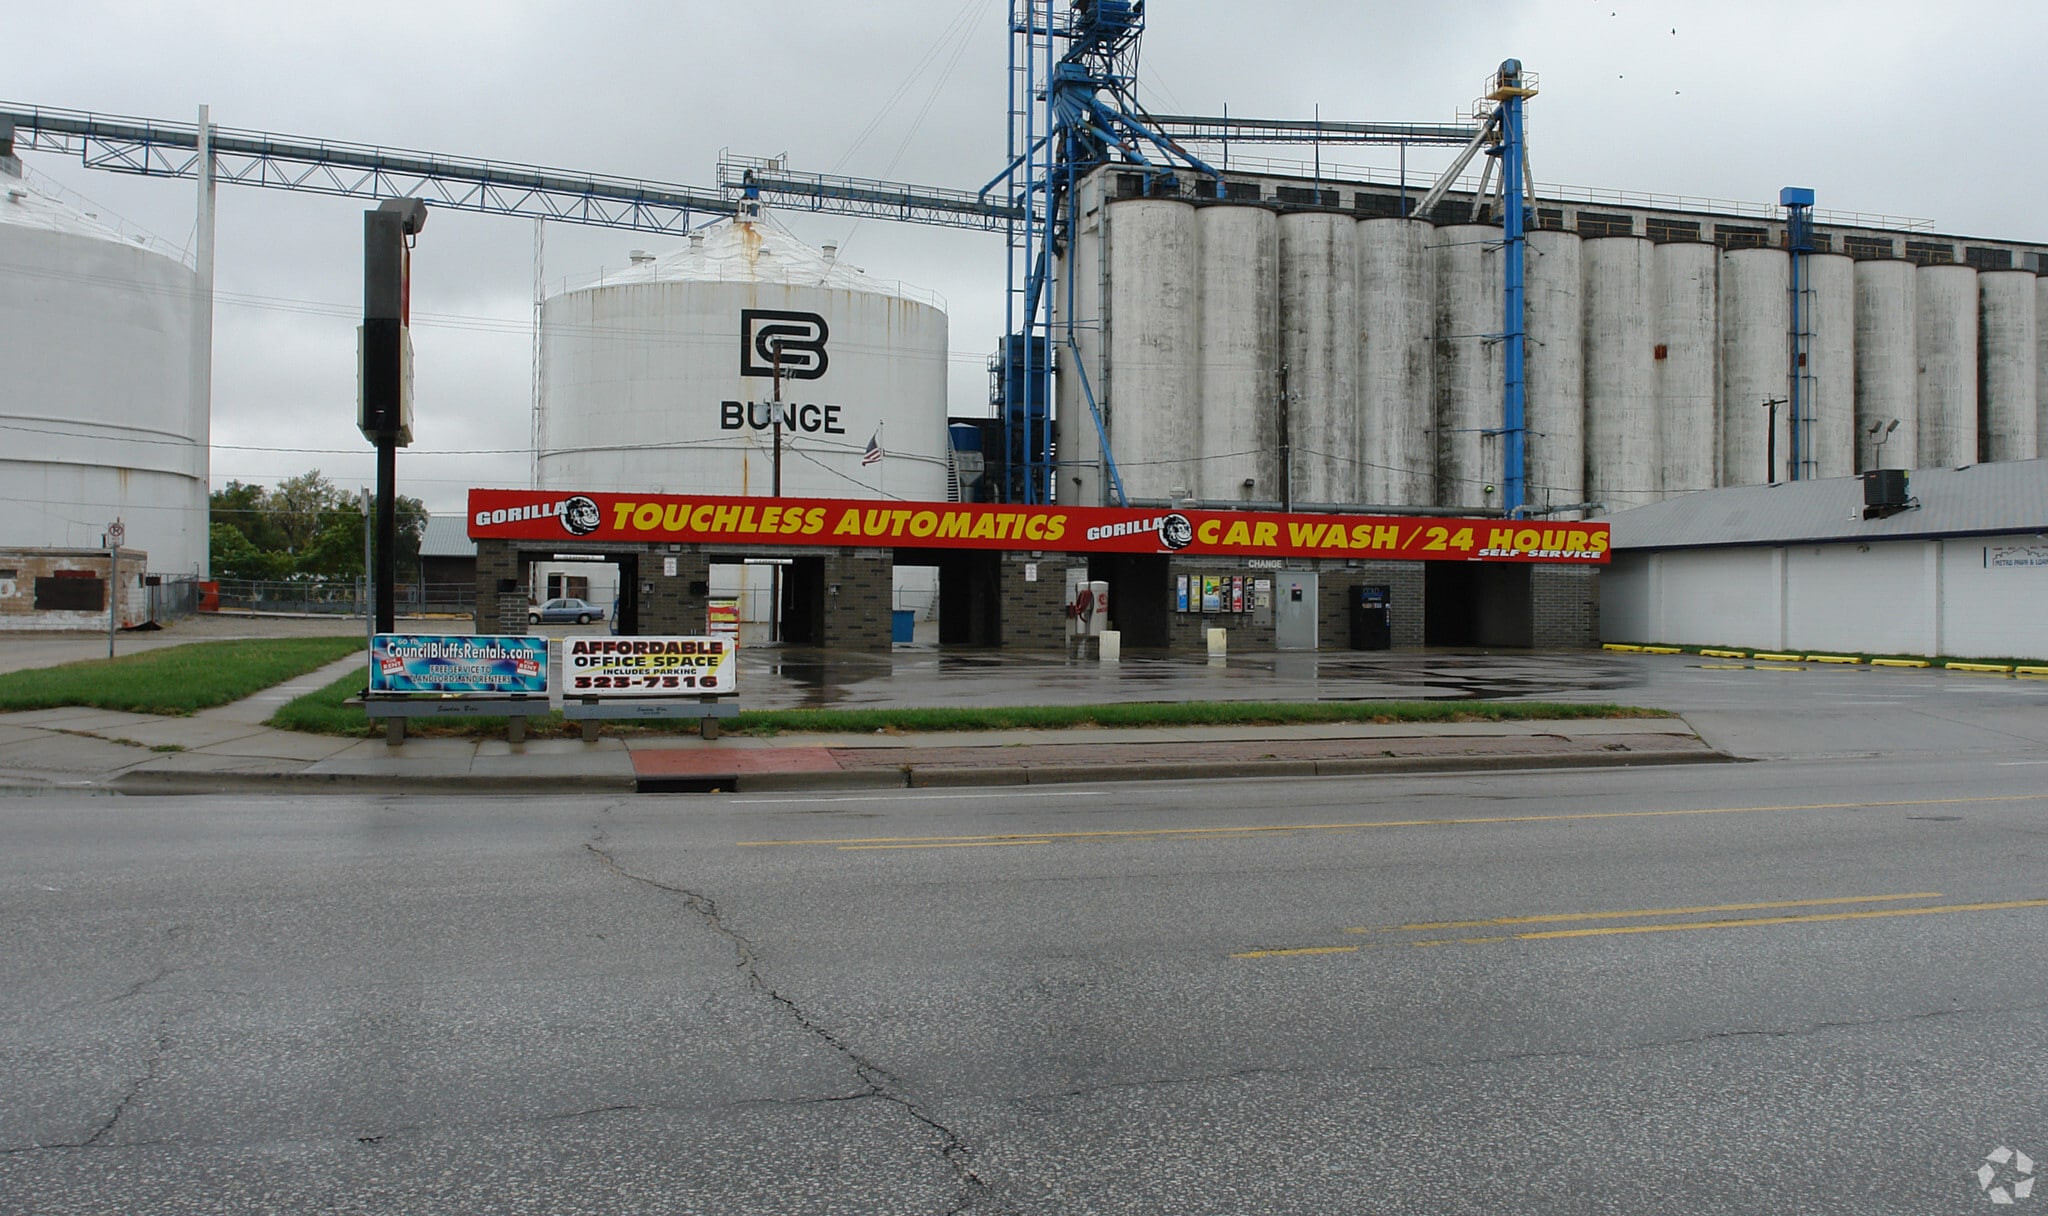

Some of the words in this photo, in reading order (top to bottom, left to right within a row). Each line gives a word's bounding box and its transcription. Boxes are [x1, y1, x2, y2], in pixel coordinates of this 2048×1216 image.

[721, 400, 846, 435] BUNGE
[475, 501, 567, 527] GORILLA
[613, 502, 826, 535] TOUCHLESS
[833, 508, 1067, 541] AUTOMATICS
[1086, 516, 1165, 541] GORILLA
[1197, 520, 1279, 547] CAR
[1487, 528, 1609, 554] HOURS
[1478, 547, 1520, 558] SELF
[1527, 548, 1602, 559] SERVICE
[1248, 559, 1282, 569] CHANGE
[387, 642, 534, 660] CouncilBluffsRentals.com
[572, 641, 723, 655] AFFORDABLE
[383, 661, 402, 670] RENT
[519, 664, 537, 672] RENT
[574, 656, 646, 667] OFFICE
[653, 656, 719, 667] SPACE
[430, 665, 448, 674] FREE
[449, 665, 480, 674] SERVICE
[481, 665, 492, 674] TO
[412, 675, 460, 683] LANDLORDS
[461, 675, 478, 684] AND
[479, 675, 512, 684] RENTERS
[574, 676, 718, 689] 323-7316
